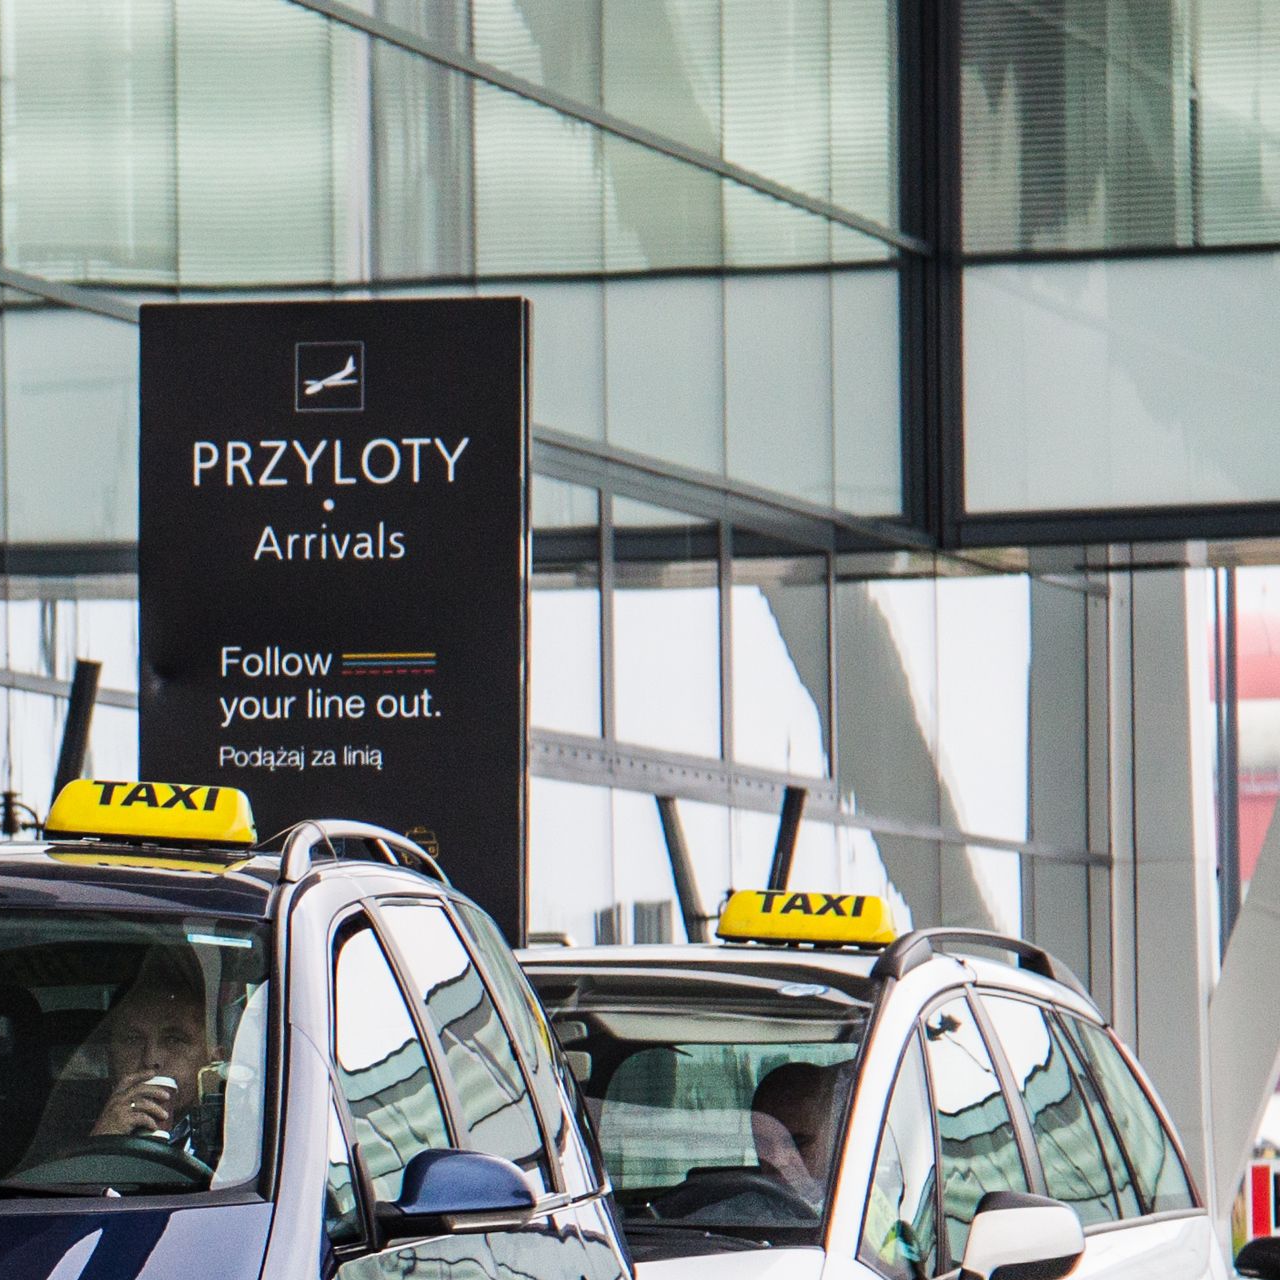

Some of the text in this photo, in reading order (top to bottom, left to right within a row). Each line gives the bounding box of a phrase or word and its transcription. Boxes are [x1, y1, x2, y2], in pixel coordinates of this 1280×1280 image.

[193, 437, 470, 487] PRZYLOTY
[253, 522, 406, 560] Arrivals
[220, 646, 332, 677] Follow
[219, 689, 442, 728] your line out.
[219, 745, 383, 772] Podążaj za linią
[93, 780, 220, 811] TAXI
[756, 891, 866, 917] TAXI
